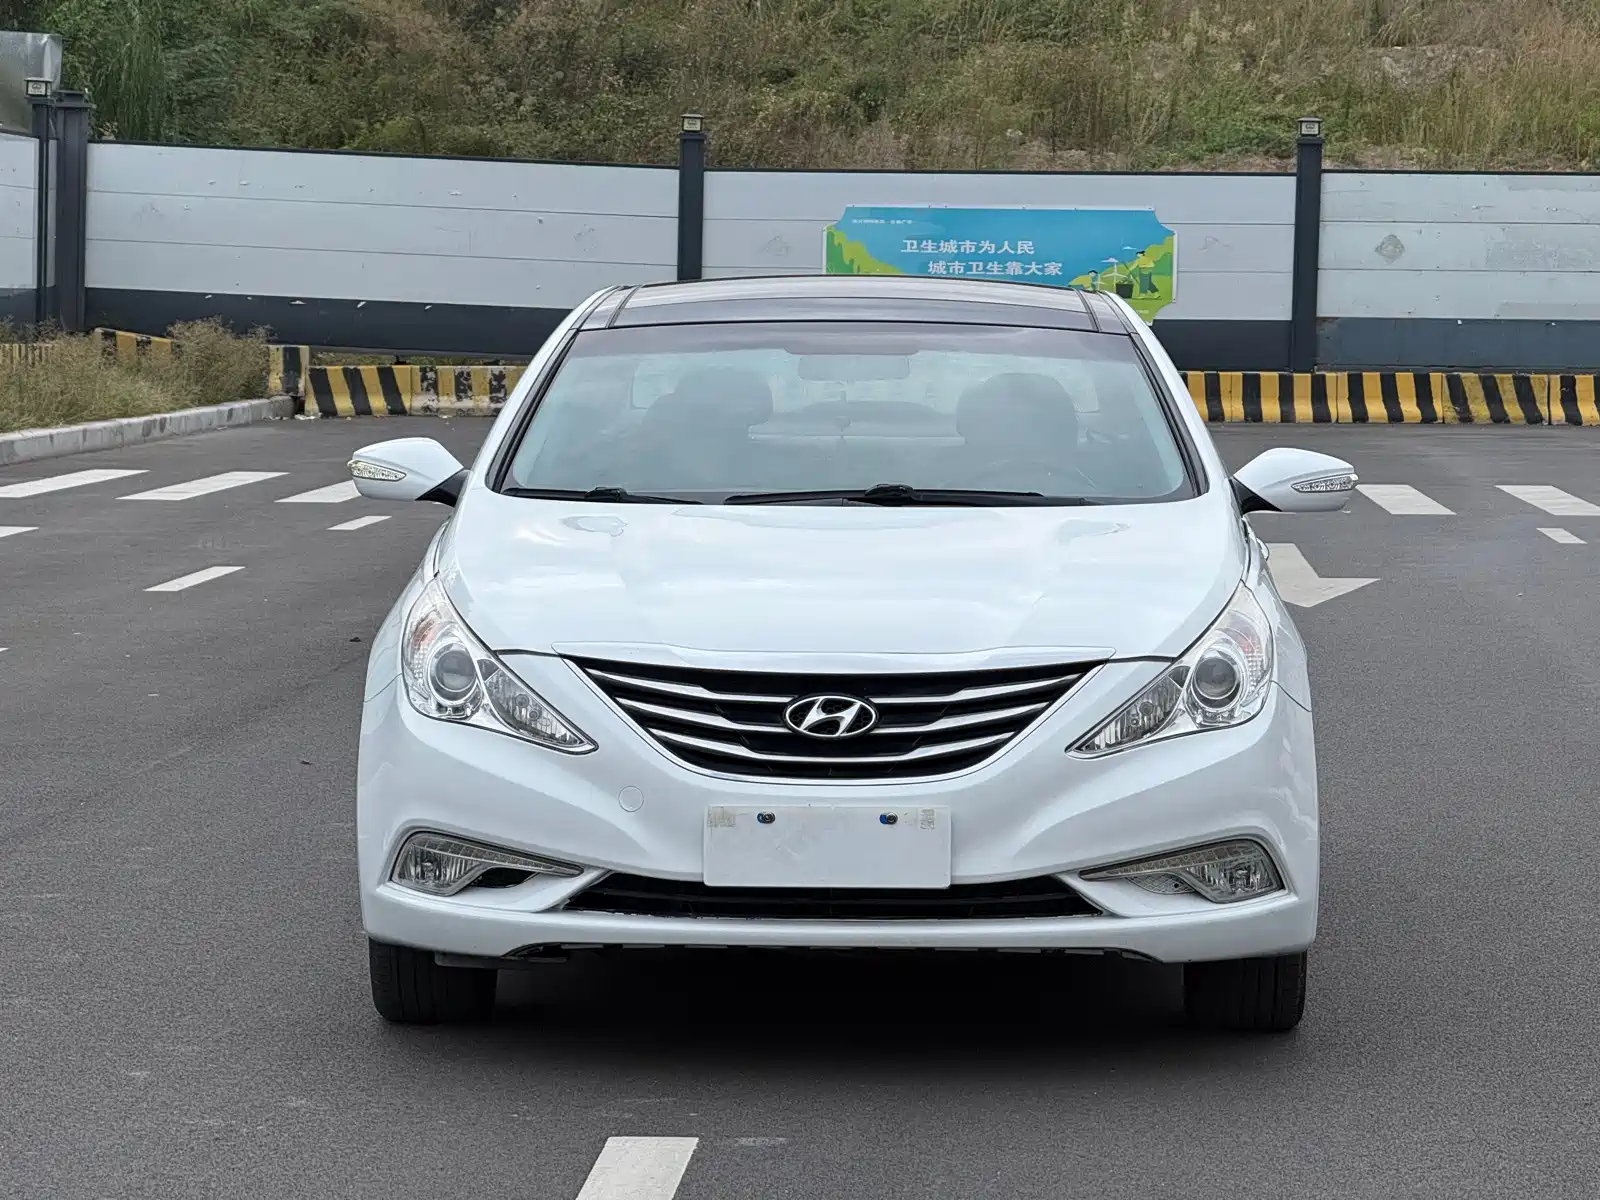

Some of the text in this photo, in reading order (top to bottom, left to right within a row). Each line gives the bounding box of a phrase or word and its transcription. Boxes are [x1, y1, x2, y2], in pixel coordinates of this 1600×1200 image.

[901, 239, 1035, 255] 卫生城市为人民
[928, 261, 1063, 276] 城市卫生靠大家
